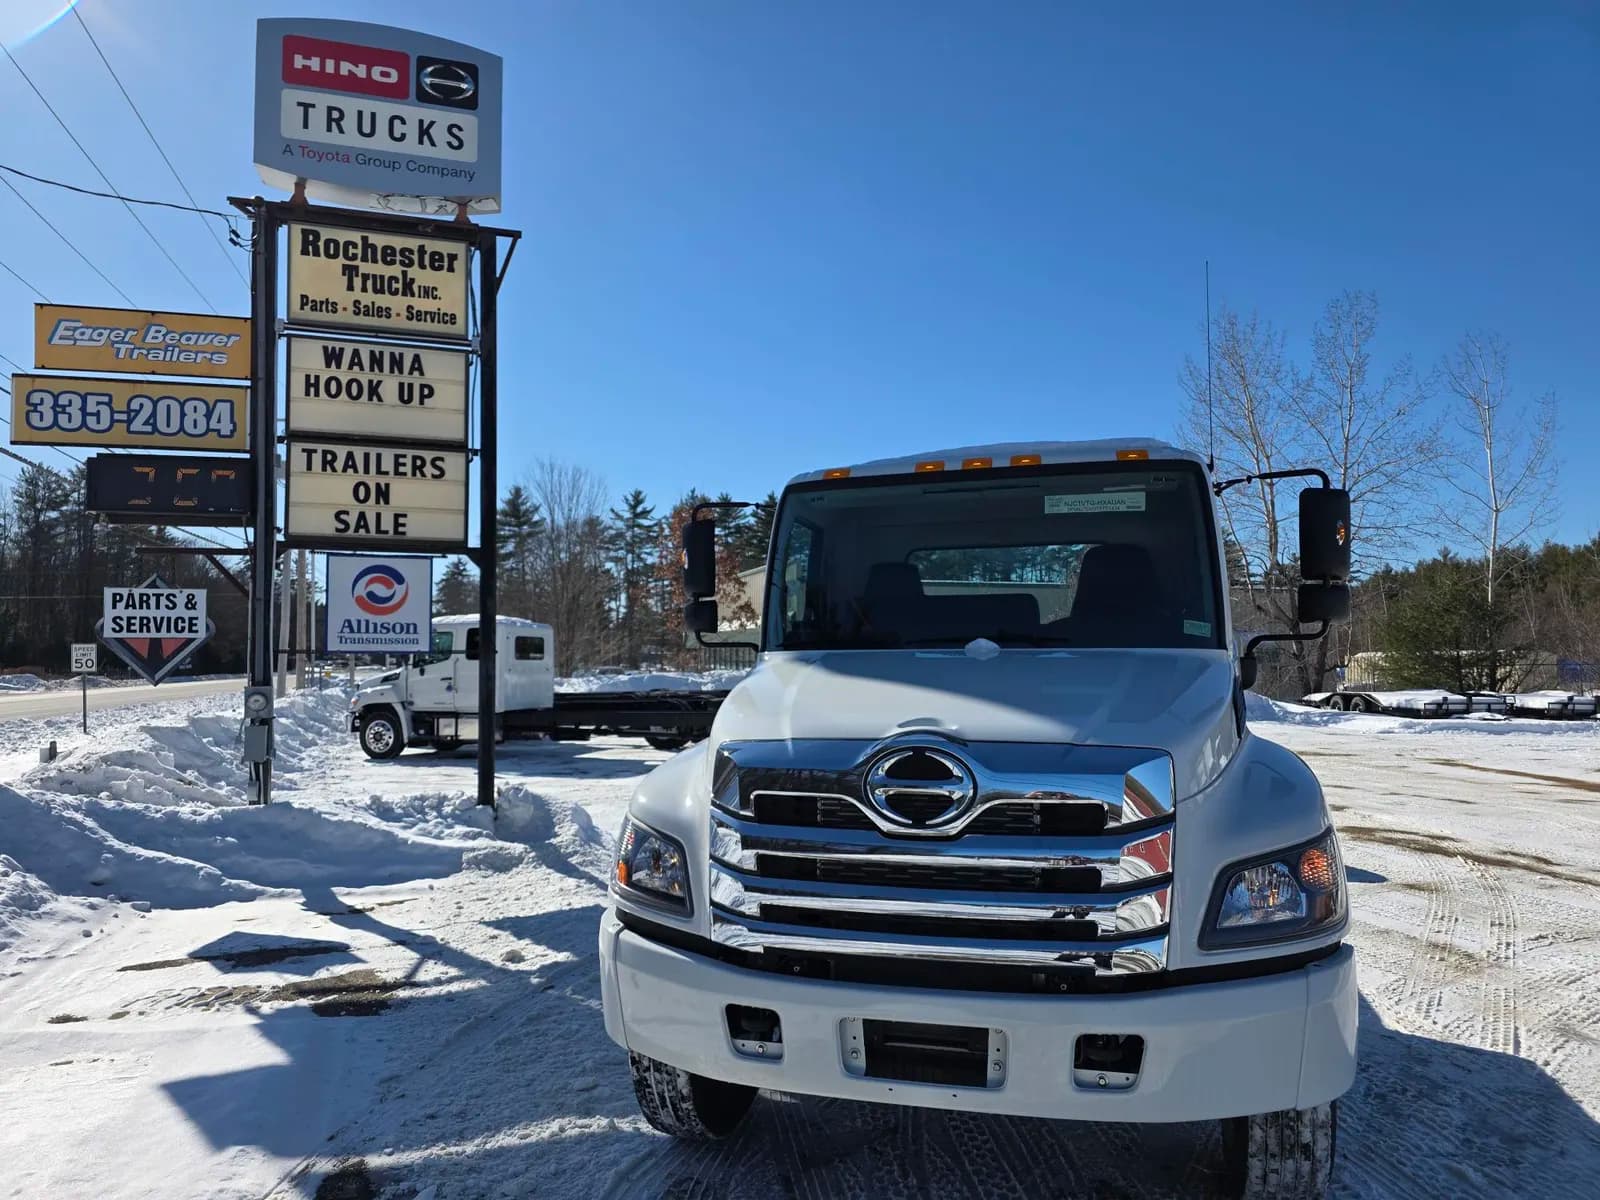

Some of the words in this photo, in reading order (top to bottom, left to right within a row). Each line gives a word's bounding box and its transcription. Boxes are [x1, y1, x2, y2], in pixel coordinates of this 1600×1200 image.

[293, 54, 399, 83] HINO
[296, 101, 465, 151] TRUCKS
[282, 144, 294, 156] A
[298, 145, 351, 164] Toyota
[355, 153, 402, 171] Group
[406, 160, 476, 182] Company
[300, 228, 459, 273] Rochester
[341, 263, 416, 297] Truck
[417, 285, 442, 300] INC.
[300, 294, 338, 314] Parts
[352, 299, 392, 319] Sales
[405, 305, 457, 325] Service
[50, 319, 138, 347] Eager
[144, 323, 241, 348] Beaver
[113, 343, 229, 365] Trailers
[322, 345, 425, 376] WANNA
[304, 374, 384, 402] HOOK
[398, 381, 435, 405] UP
[26, 389, 236, 438] 335-2084
[301, 448, 446, 479] TRAILERS
[352, 481, 390, 505] ON
[334, 510, 408, 536] SALE
[111, 592, 178, 610] PARTS
[184, 592, 197, 611] &
[111, 615, 199, 634] SERVICE
[338, 618, 419, 635] Allison
[337, 635, 419, 645] Transmission
[74, 658, 95, 669] 50
